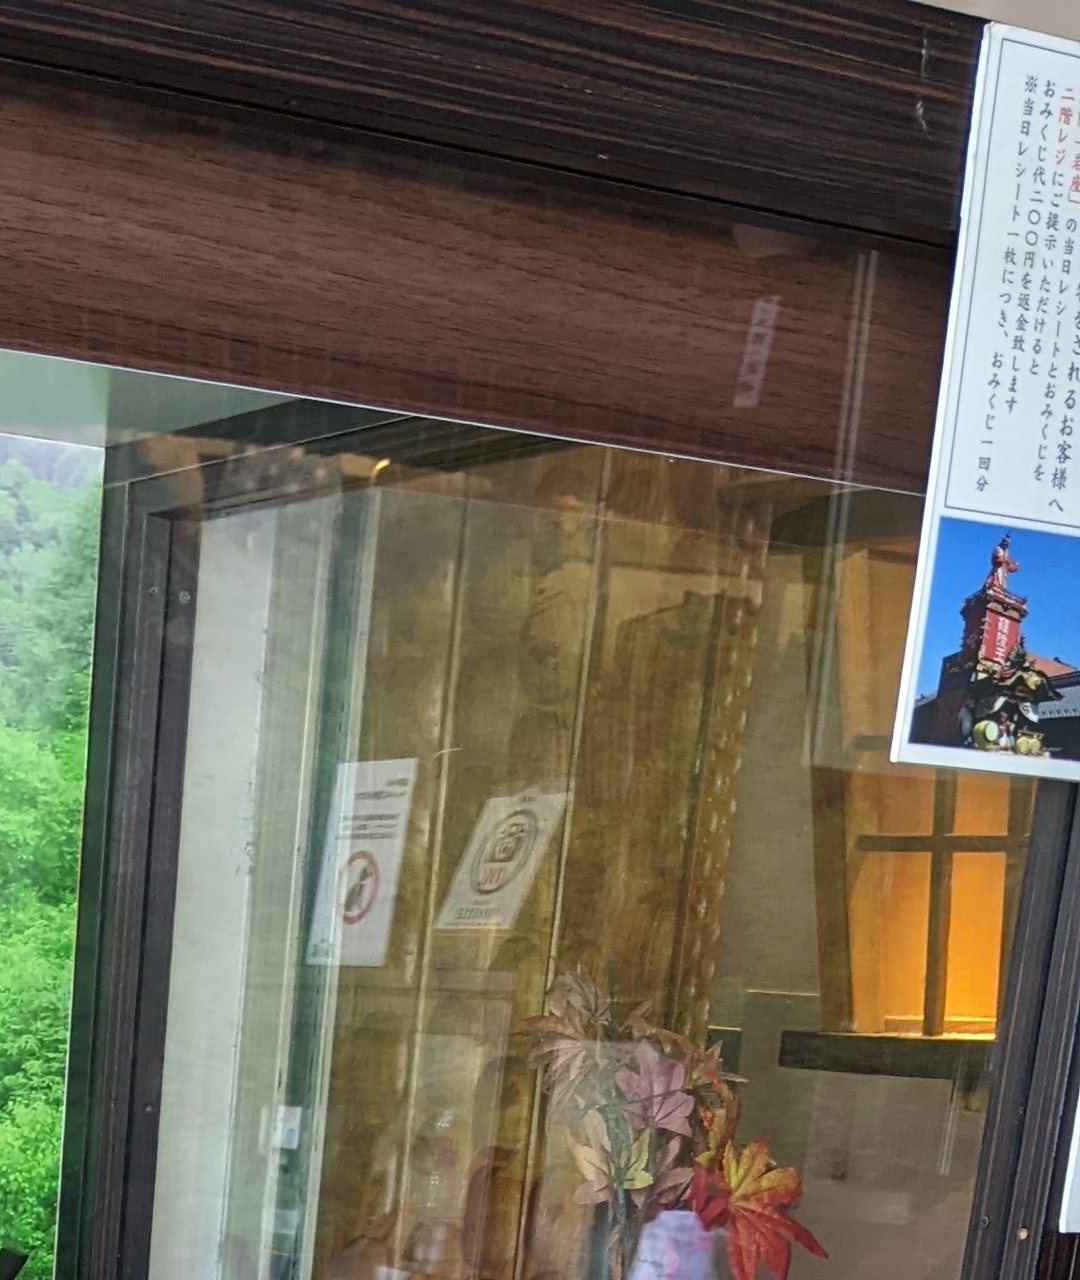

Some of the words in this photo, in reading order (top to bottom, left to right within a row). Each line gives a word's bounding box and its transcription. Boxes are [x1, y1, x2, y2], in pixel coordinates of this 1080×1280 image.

[1029, 88, 1075, 375] 二階レジにご提示いただけると
